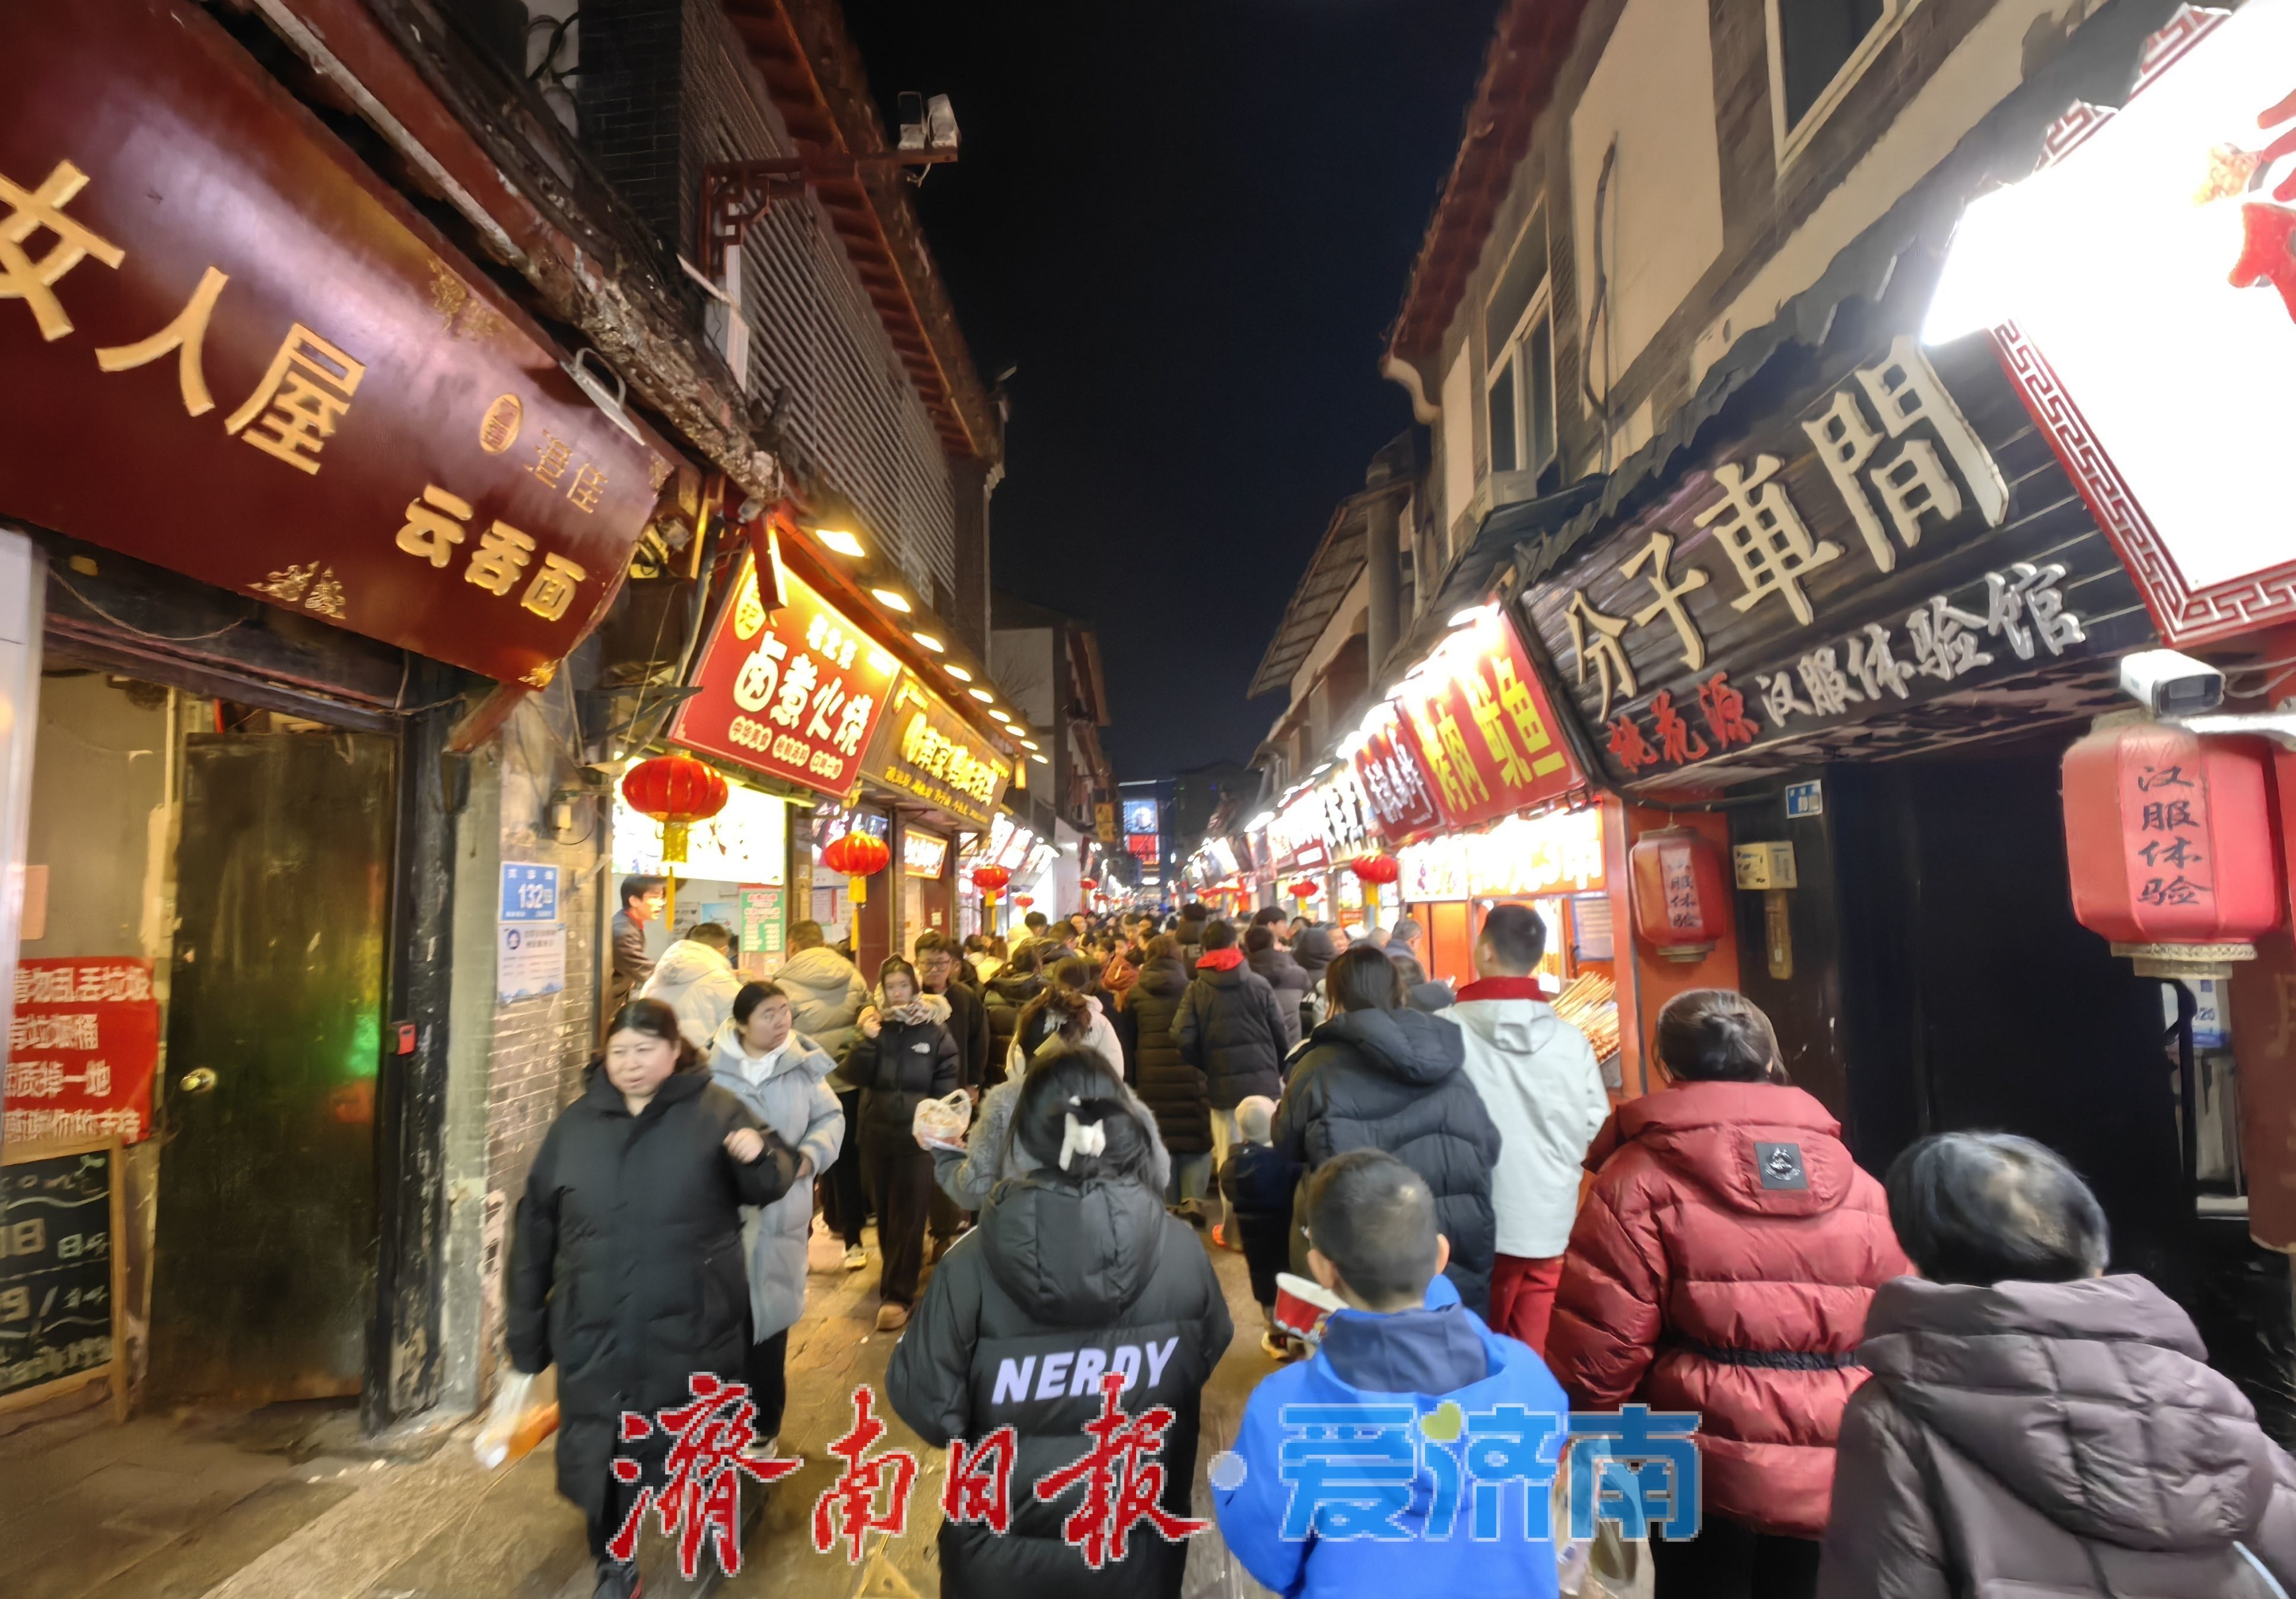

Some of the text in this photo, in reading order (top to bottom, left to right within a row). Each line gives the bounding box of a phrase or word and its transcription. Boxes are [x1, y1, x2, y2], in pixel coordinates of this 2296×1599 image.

[0, 158, 367, 475] 女人屋
[395, 483, 587, 621] 云吞面
[733, 630, 874, 756] 卤煮火烧
[1756, 562, 2087, 728] 汉服体验馆
[2137, 765, 2212, 906] 汉服体验
[991, 1336, 1179, 1405] NERDY
